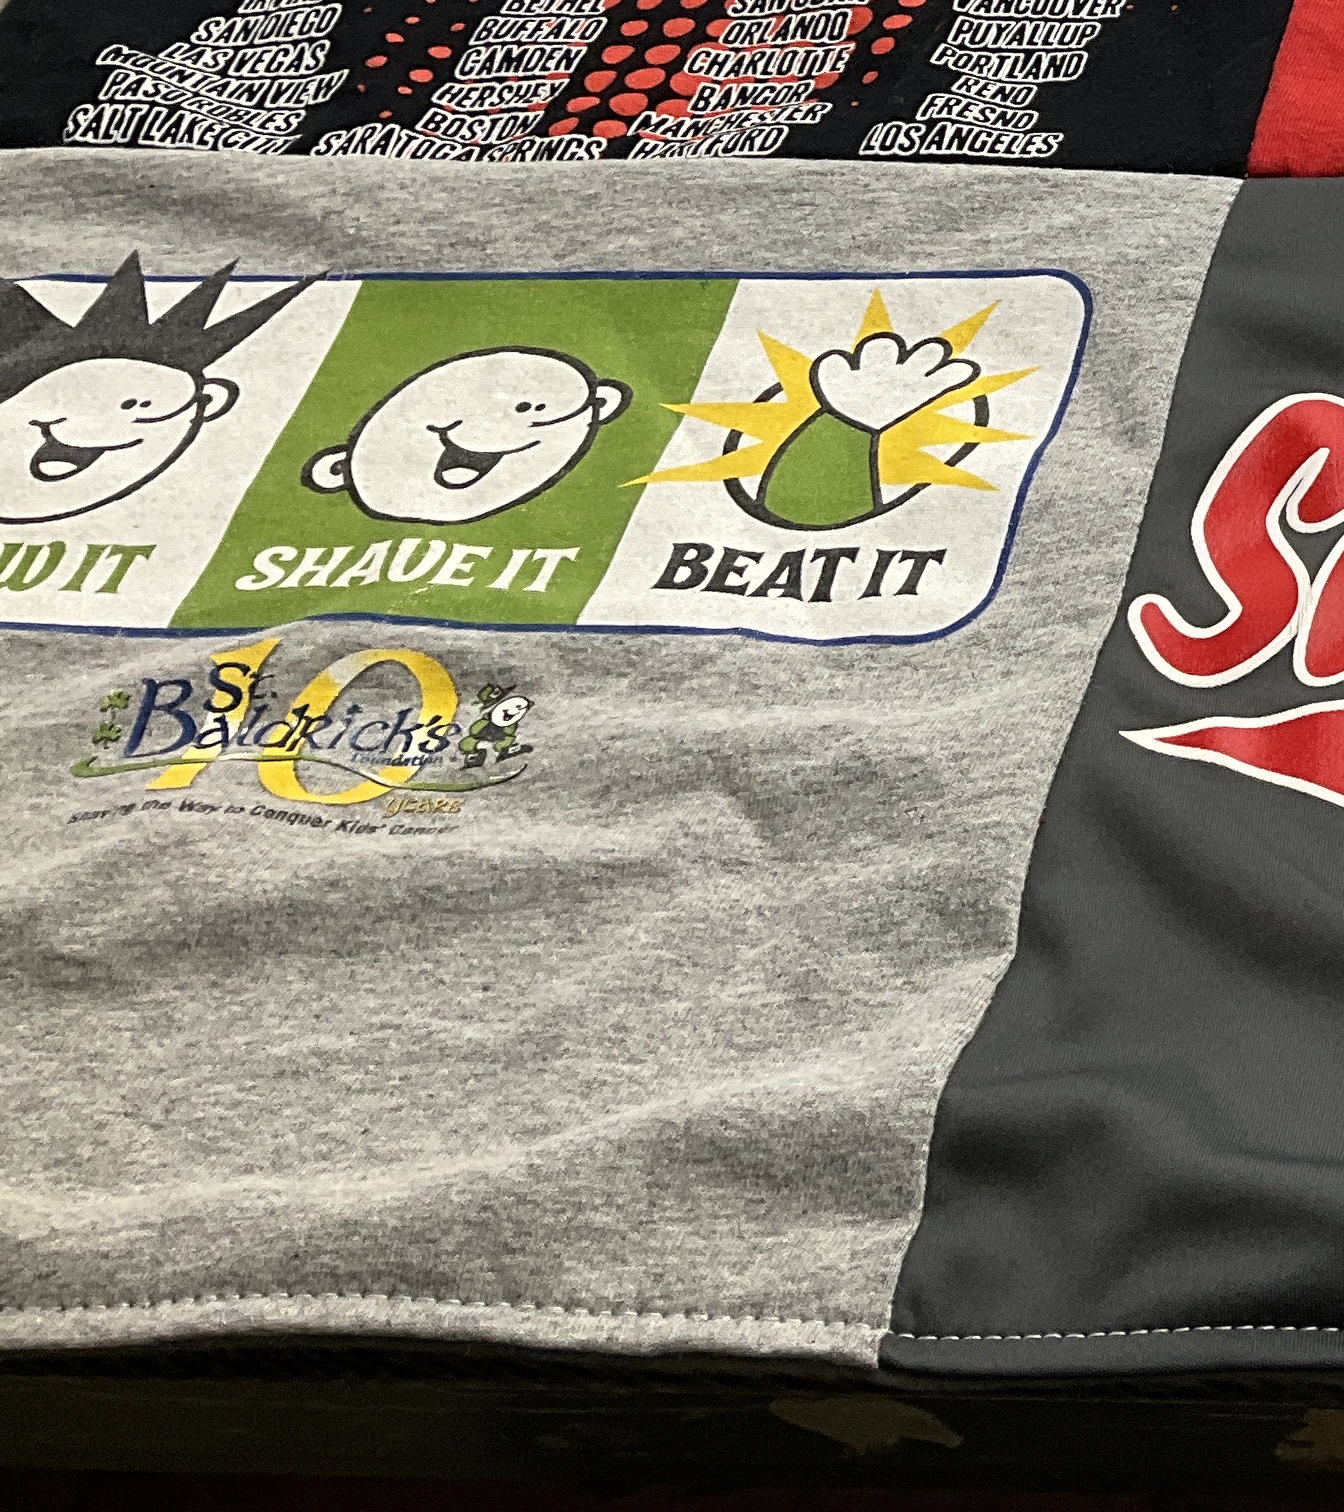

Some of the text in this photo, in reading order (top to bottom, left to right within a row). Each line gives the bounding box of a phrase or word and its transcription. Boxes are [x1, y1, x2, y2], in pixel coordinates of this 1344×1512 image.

[190, 3, 343, 47] SAN DIEGO
[468, 16, 608, 46] BUFFALO
[719, 8, 853, 47] ORLANDO
[948, 15, 1102, 49] PUYALLUP
[96, 44, 350, 108] MOUNTAIN VIEW
[158, 40, 331, 77] LAS VEGAS
[454, 44, 588, 80] CAMDEN
[684, 42, 856, 81] CHARLOTTE
[930, 43, 1089, 83] PORTLAND
[98, 69, 307, 135] PASO ROBLES
[431, 79, 570, 112] HERSHEY
[687, 80, 816, 115] BANGOR
[951, 75, 1038, 108] RENO
[63, 104, 151, 144] SALT
[139, 107, 229, 151] LAKE
[416, 108, 545, 144] BOSTON
[627, 101, 833, 141] MANCHESTER
[915, 93, 1039, 132] FRESNO
[859, 120, 1064, 159] LOS ANGELES
[58, 543, 158, 592] IT
[234, 537, 581, 595] SHAVE IT
[651, 541, 949, 606] BEAT IT
[250, 803, 333, 830] Conquer
